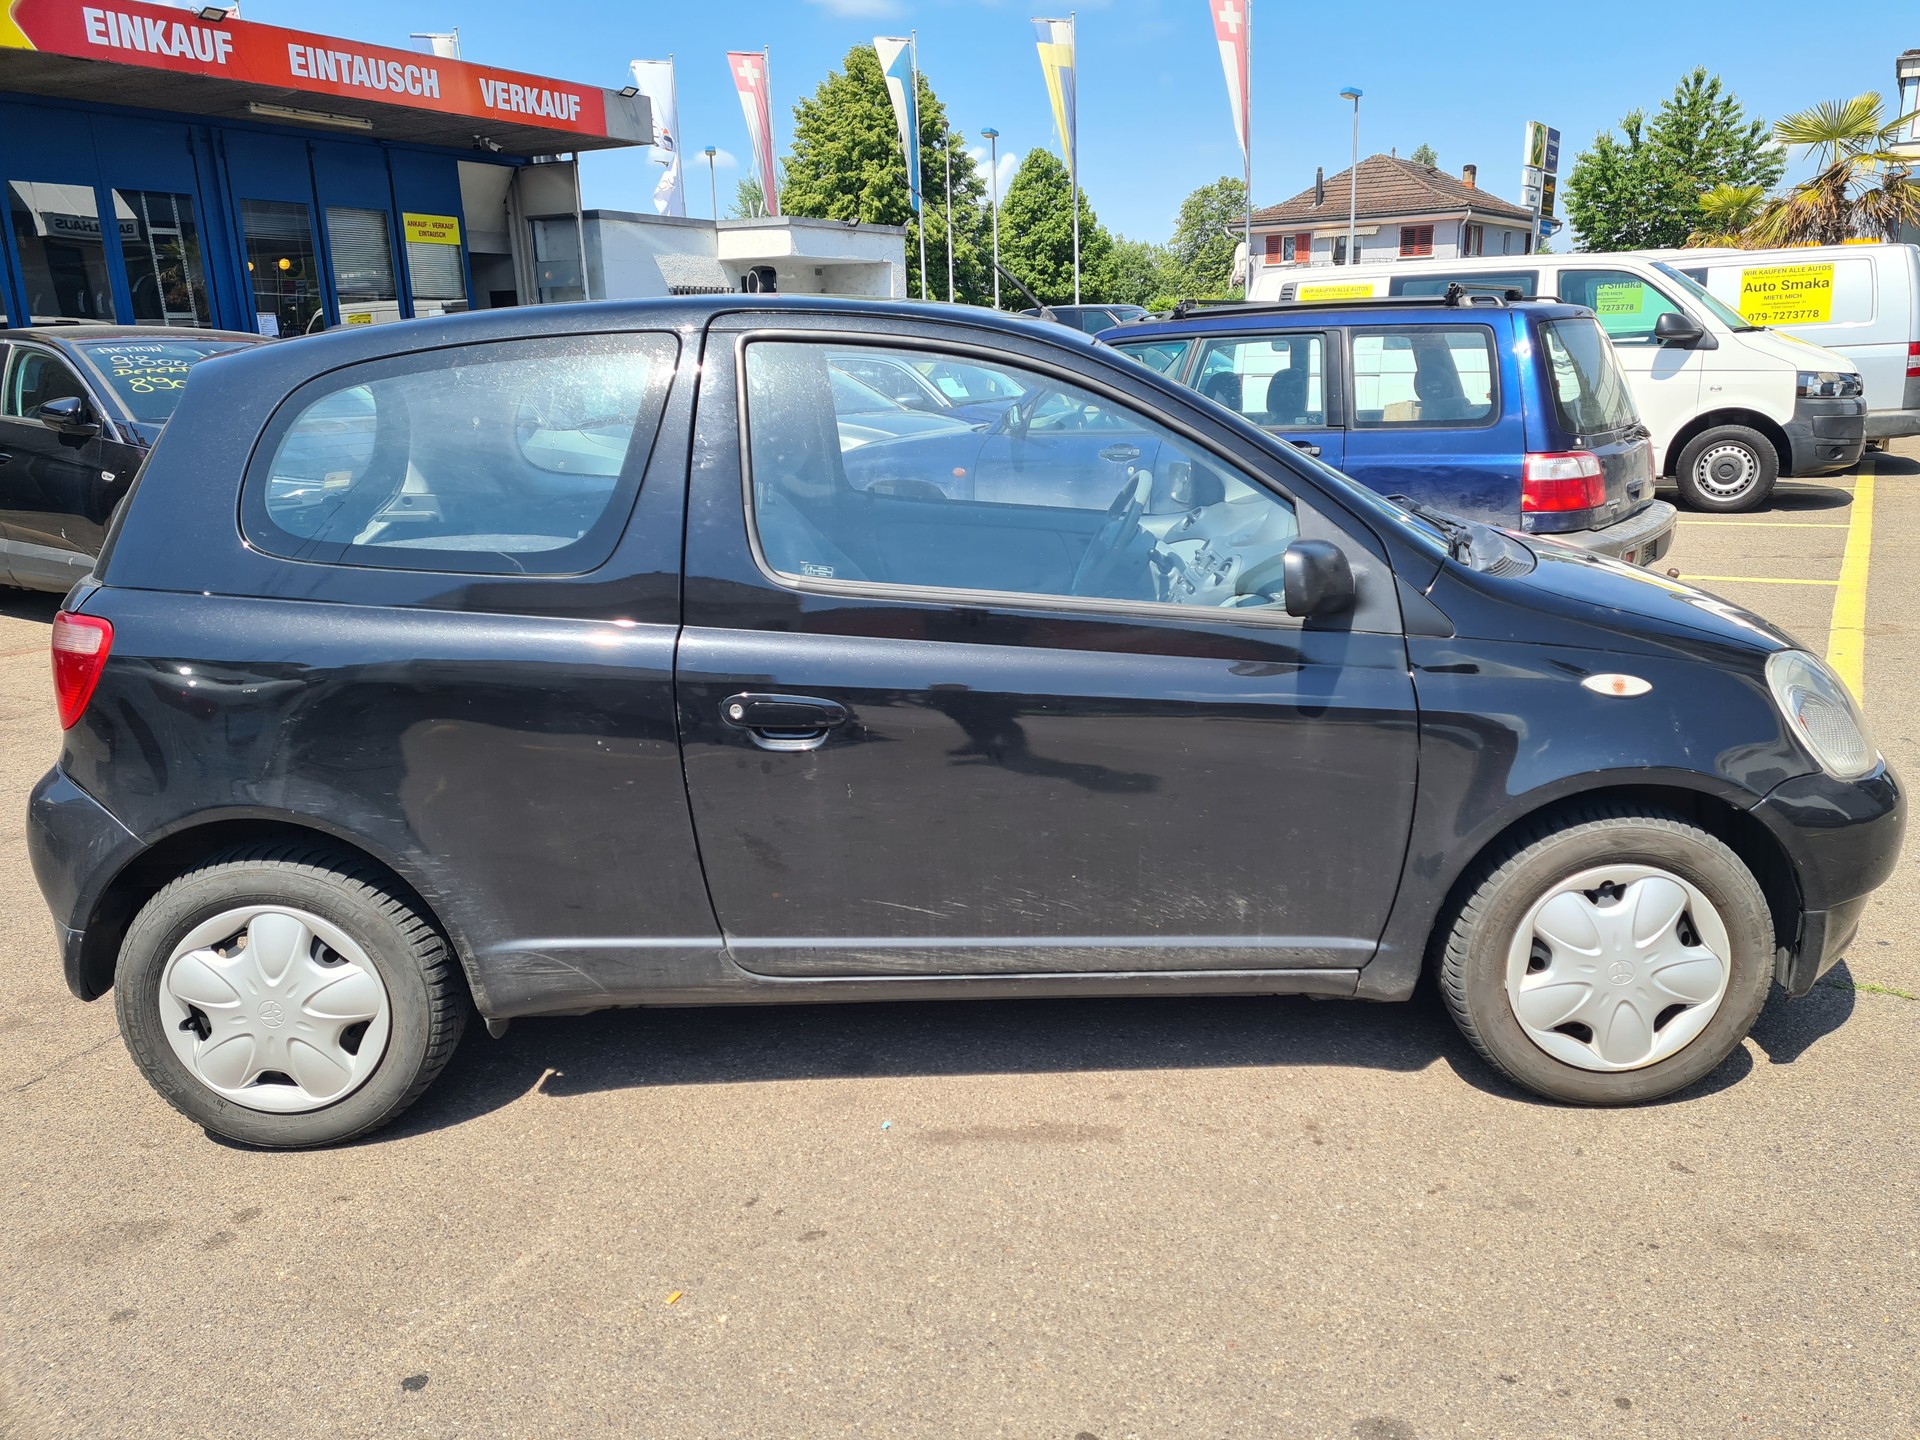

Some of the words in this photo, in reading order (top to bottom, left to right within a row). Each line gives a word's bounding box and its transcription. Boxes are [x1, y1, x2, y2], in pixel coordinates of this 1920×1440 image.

[82, 6, 233, 65] EINKAUF
[287, 43, 441, 99] EINTAUSCH
[478, 77, 581, 122] VERKAUF
[407, 220, 428, 228] ANKAUF
[431, 221, 455, 230] VERKAUF
[418, 229, 447, 238] EINTAUSCH
[1807, 264, 1832, 272] AUTOS
[1743, 282, 1776, 293] Auto
[1780, 277, 1830, 291] Smaka
[1763, 293, 1783, 301] MIETE
[1747, 309, 1820, 322] 079-7273778
